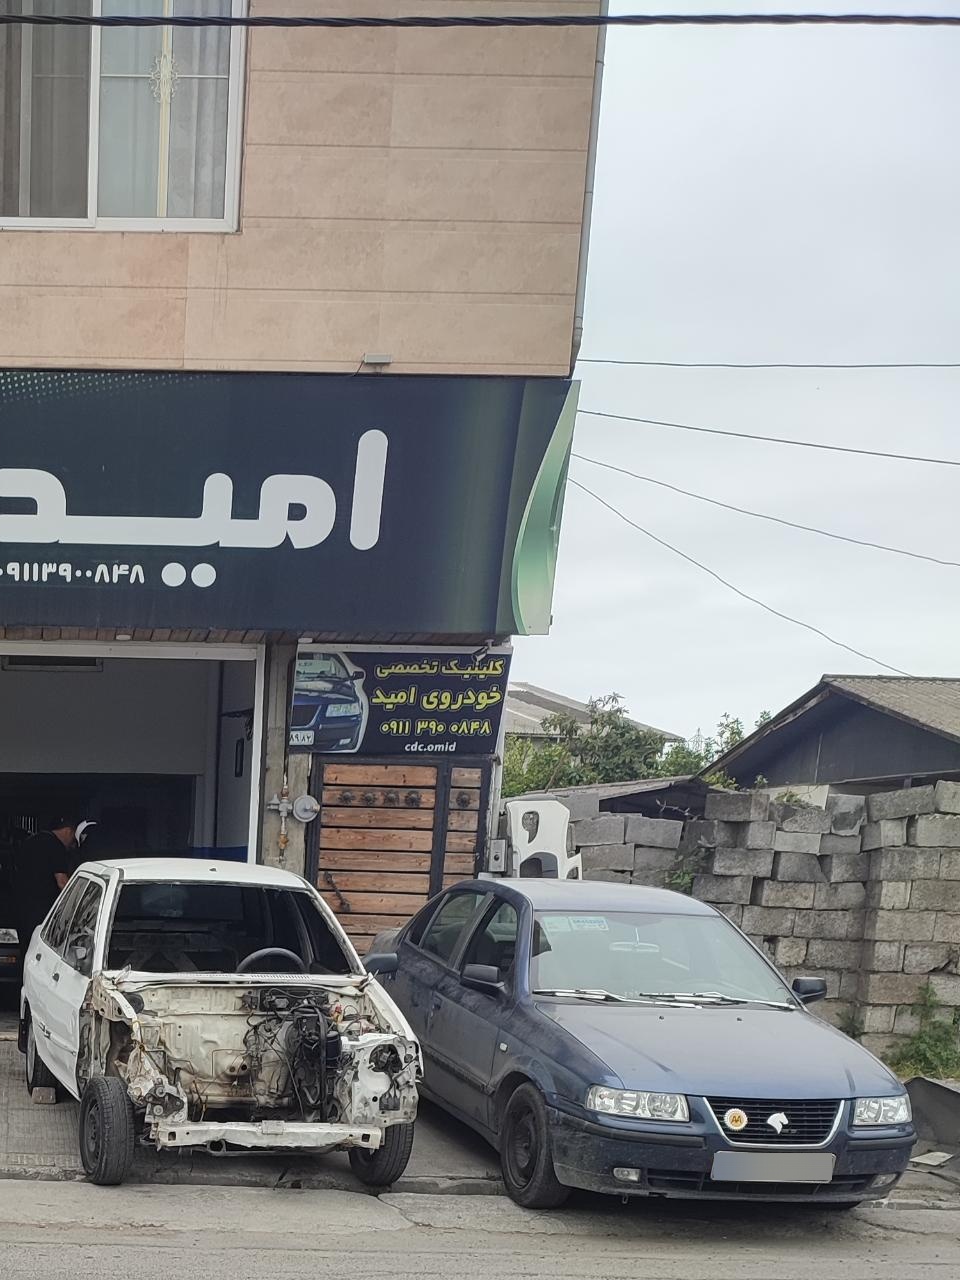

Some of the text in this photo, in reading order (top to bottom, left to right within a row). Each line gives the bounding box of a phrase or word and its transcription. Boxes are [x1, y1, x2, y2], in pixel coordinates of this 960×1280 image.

[376, 658, 504, 679] کلینیک تخصصی
[371, 685, 502, 711] خودروی امید
[381, 719, 492, 735] ۰۹۱۱ ۳۹۰ ۰۸۴۸
[404, 741, 457, 752] cdc.omid
